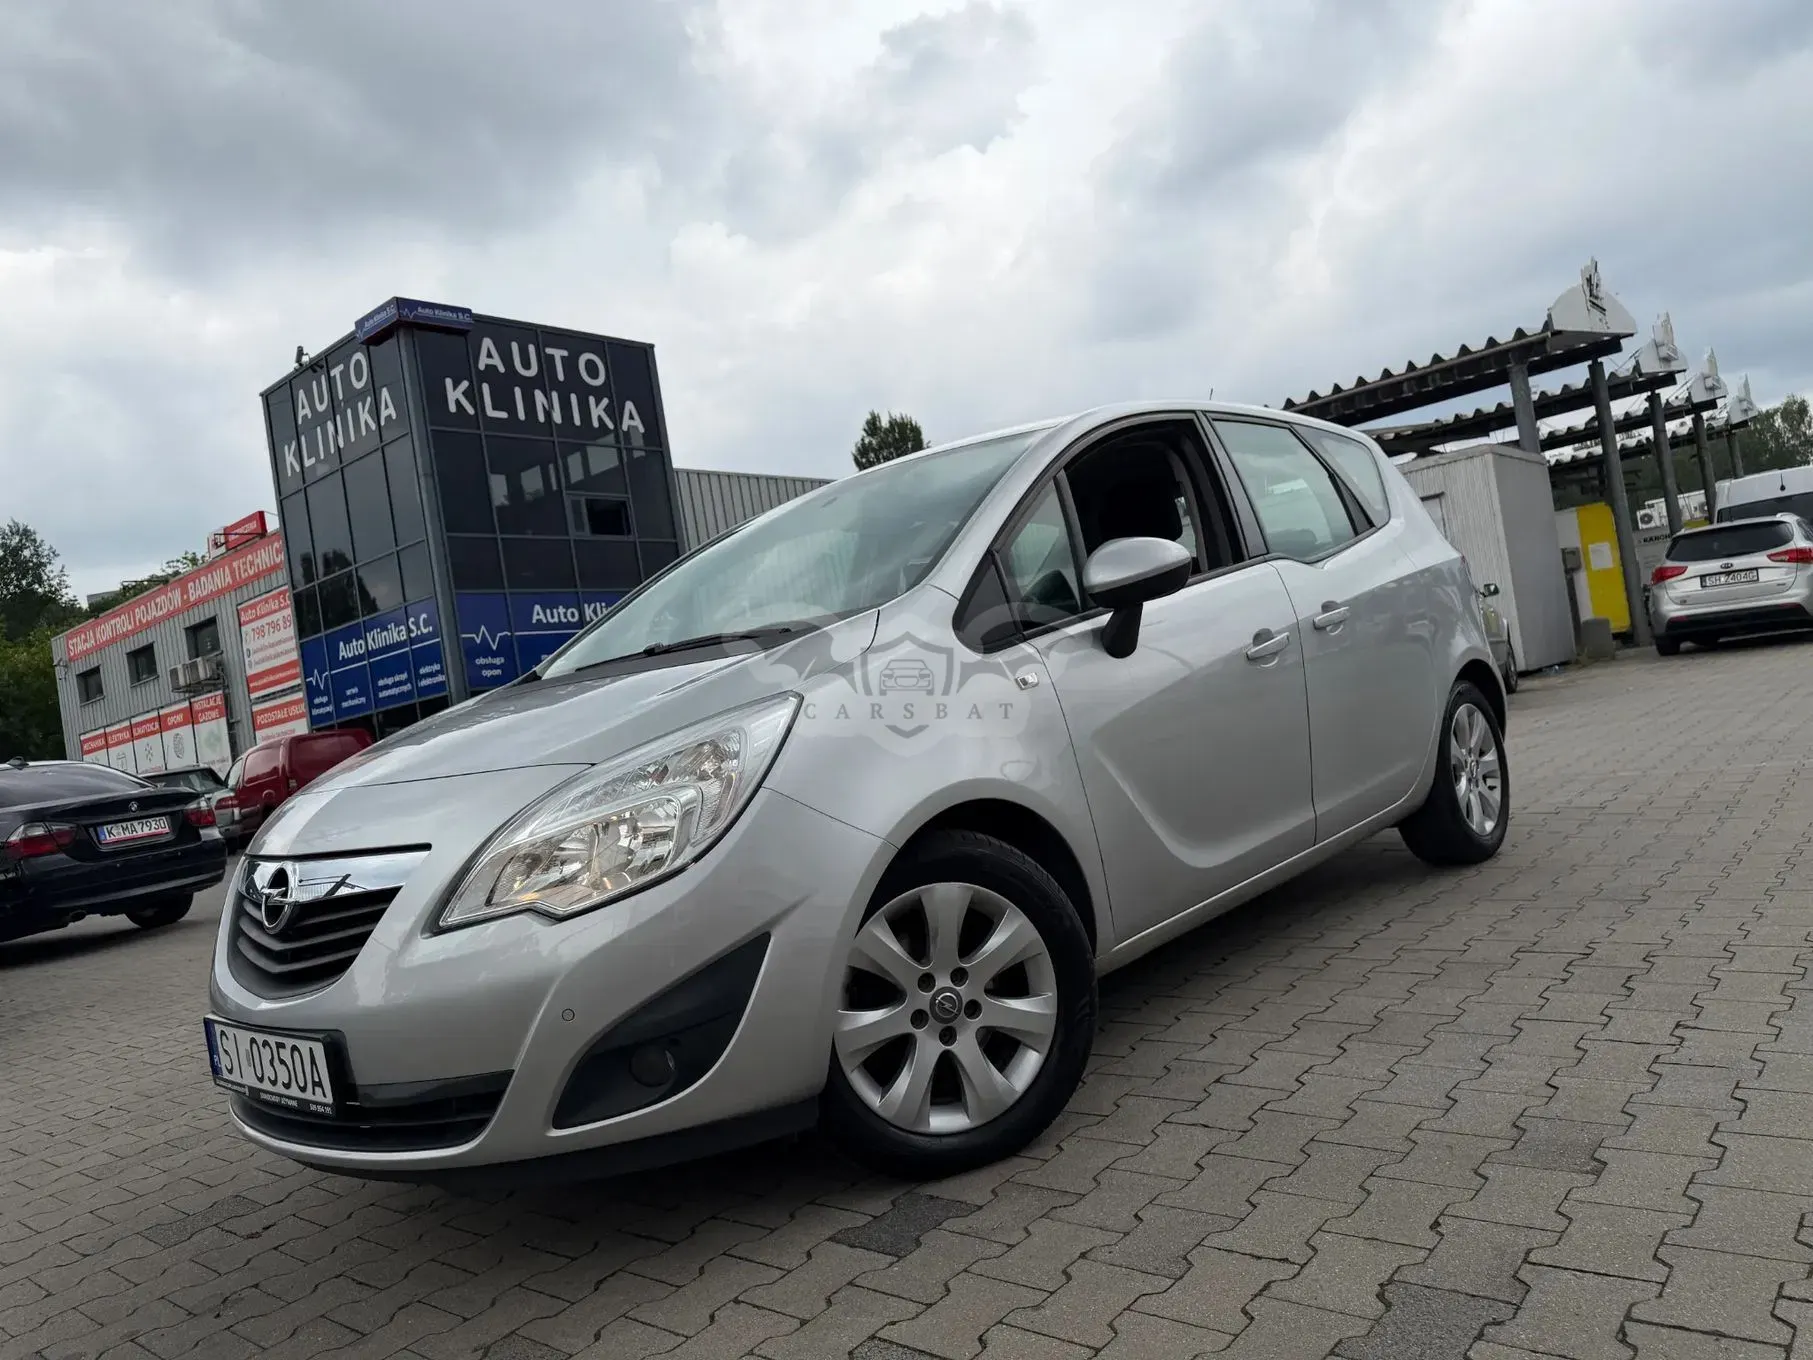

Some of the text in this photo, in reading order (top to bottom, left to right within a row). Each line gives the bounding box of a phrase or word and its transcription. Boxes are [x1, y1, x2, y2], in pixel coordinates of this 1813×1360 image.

[478, 337, 606, 387] AUTO
[297, 351, 368, 425] AUTO
[444, 377, 645, 434] KLINIKA
[284, 386, 397, 477] KLINIKA
[68, 630, 95, 656] STACJA
[95, 614, 134, 645] KONTROLI
[134, 587, 182, 627] POJAZDÓW
[187, 569, 233, 600] BADANIA
[241, 608, 257, 622] Auto
[251, 624, 266, 641] 798
[265, 618, 281, 636] 796
[338, 613, 433, 661] Auto Klinika S.C.
[532, 603, 580, 624] Auto
[256, 707, 289, 725] POZOSTAŁE
[106, 826, 116, 838] K
[220, 1029, 328, 1099] SI 0350A
